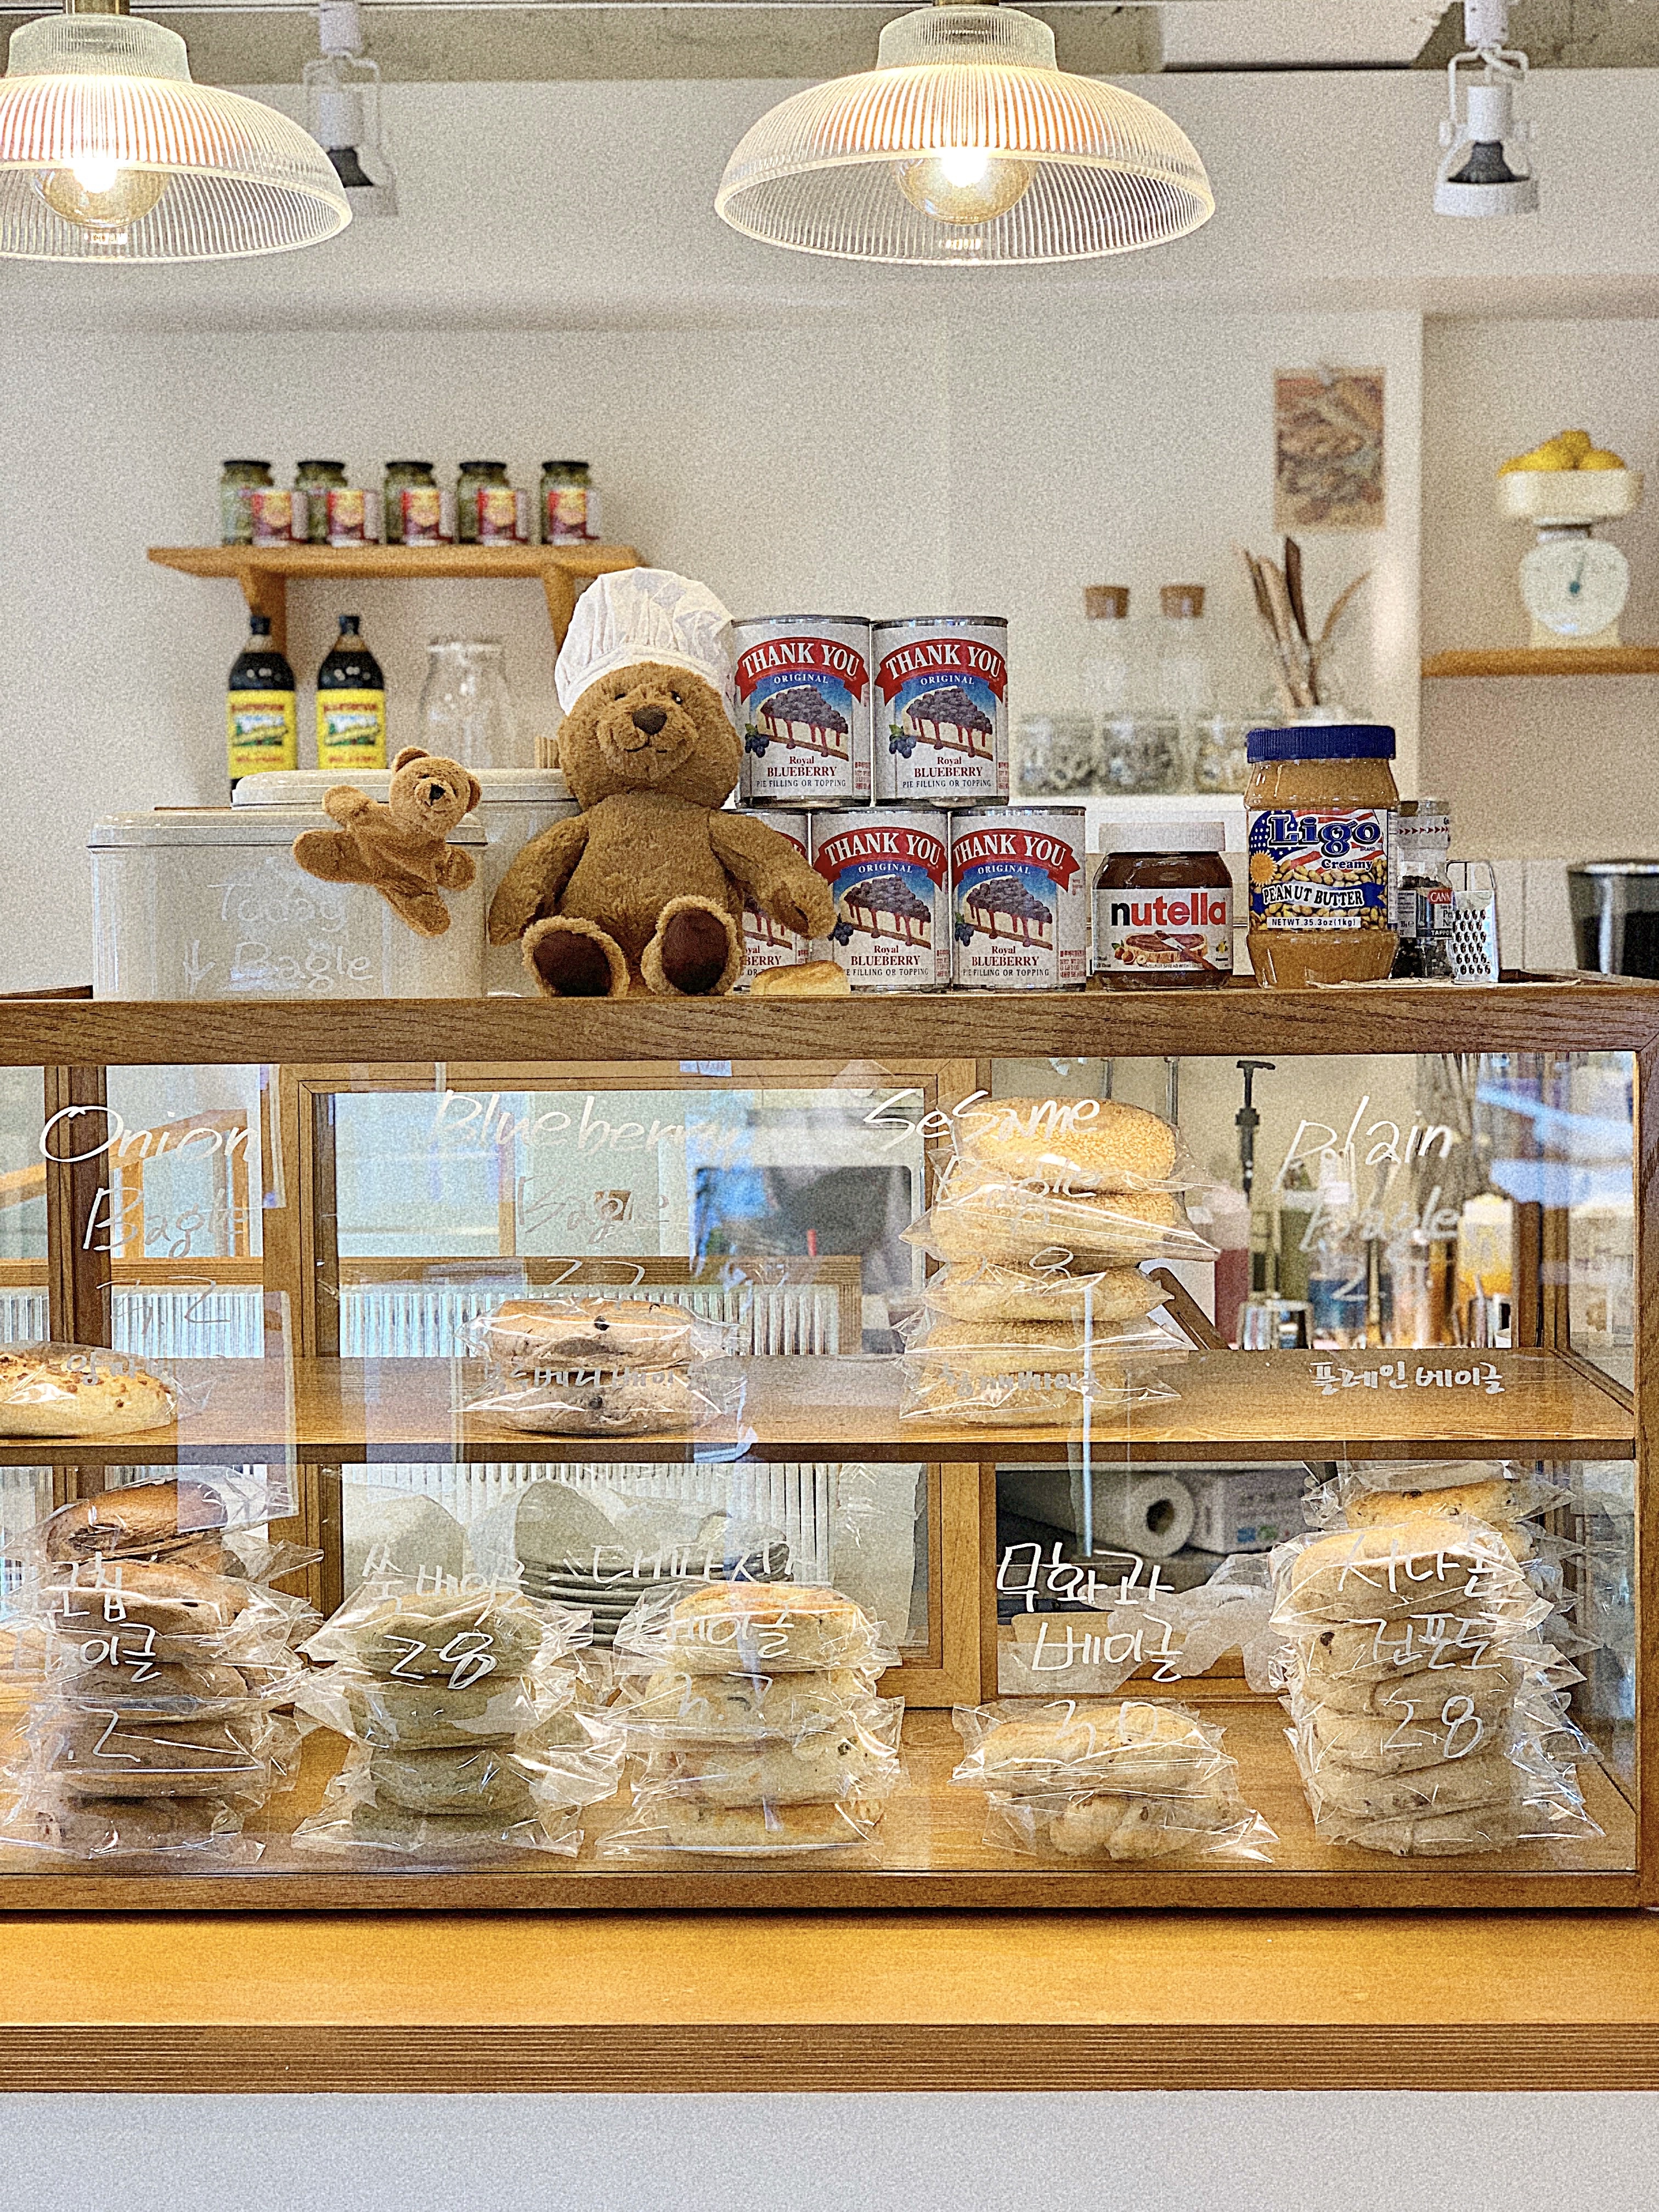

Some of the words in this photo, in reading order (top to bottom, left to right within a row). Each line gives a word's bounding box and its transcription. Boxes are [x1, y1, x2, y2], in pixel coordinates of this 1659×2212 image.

[742, 642, 815, 678] THANK
[821, 644, 860, 676] YOU
[886, 644, 961, 680] THANK
[967, 646, 1002, 678] YOU
[774, 674, 828, 684] ORIGINAL
[921, 675, 974, 685] ORIGINAL
[768, 766, 837, 777] BLUEBERRY
[789, 756, 814, 766] Royal
[937, 757, 961, 766] Royal
[915, 767, 983, 777] BLUEBERRY
[1268, 816, 1381, 857] Ligo
[825, 832, 899, 866] THANK
[906, 834, 941, 865] YOU
[953, 834, 1017, 867] THANK
[1023, 836, 1066, 866] YOU
[858, 863, 913, 873] ORIGINAL
[978, 865, 1031, 874] ORIGINAL
[1322, 859, 1373, 870] Creamy
[1263, 885, 1312, 904] PEANUT
[1314, 889, 1363, 906] BUTTER
[1111, 893, 1226, 927] nutella
[851, 955, 921, 966] BLUEBERRY
[874, 945, 899, 955] Royal
[992, 946, 1015, 956] Royal
[972, 956, 1040, 966] BLUEBERRY
[40, 1105, 259, 1163] Onion
[1310, 1361, 1409, 1395] 플레인
[1415, 1362, 1505, 1395] 베이글
[1337, 1532, 1499, 1599] 시나몬
[996, 1541, 1175, 1613] 무화과
[1031, 1613, 1184, 1683] 베이글
[383, 1631, 498, 1690] 2.8
[1379, 1695, 1485, 1759] 2.8
